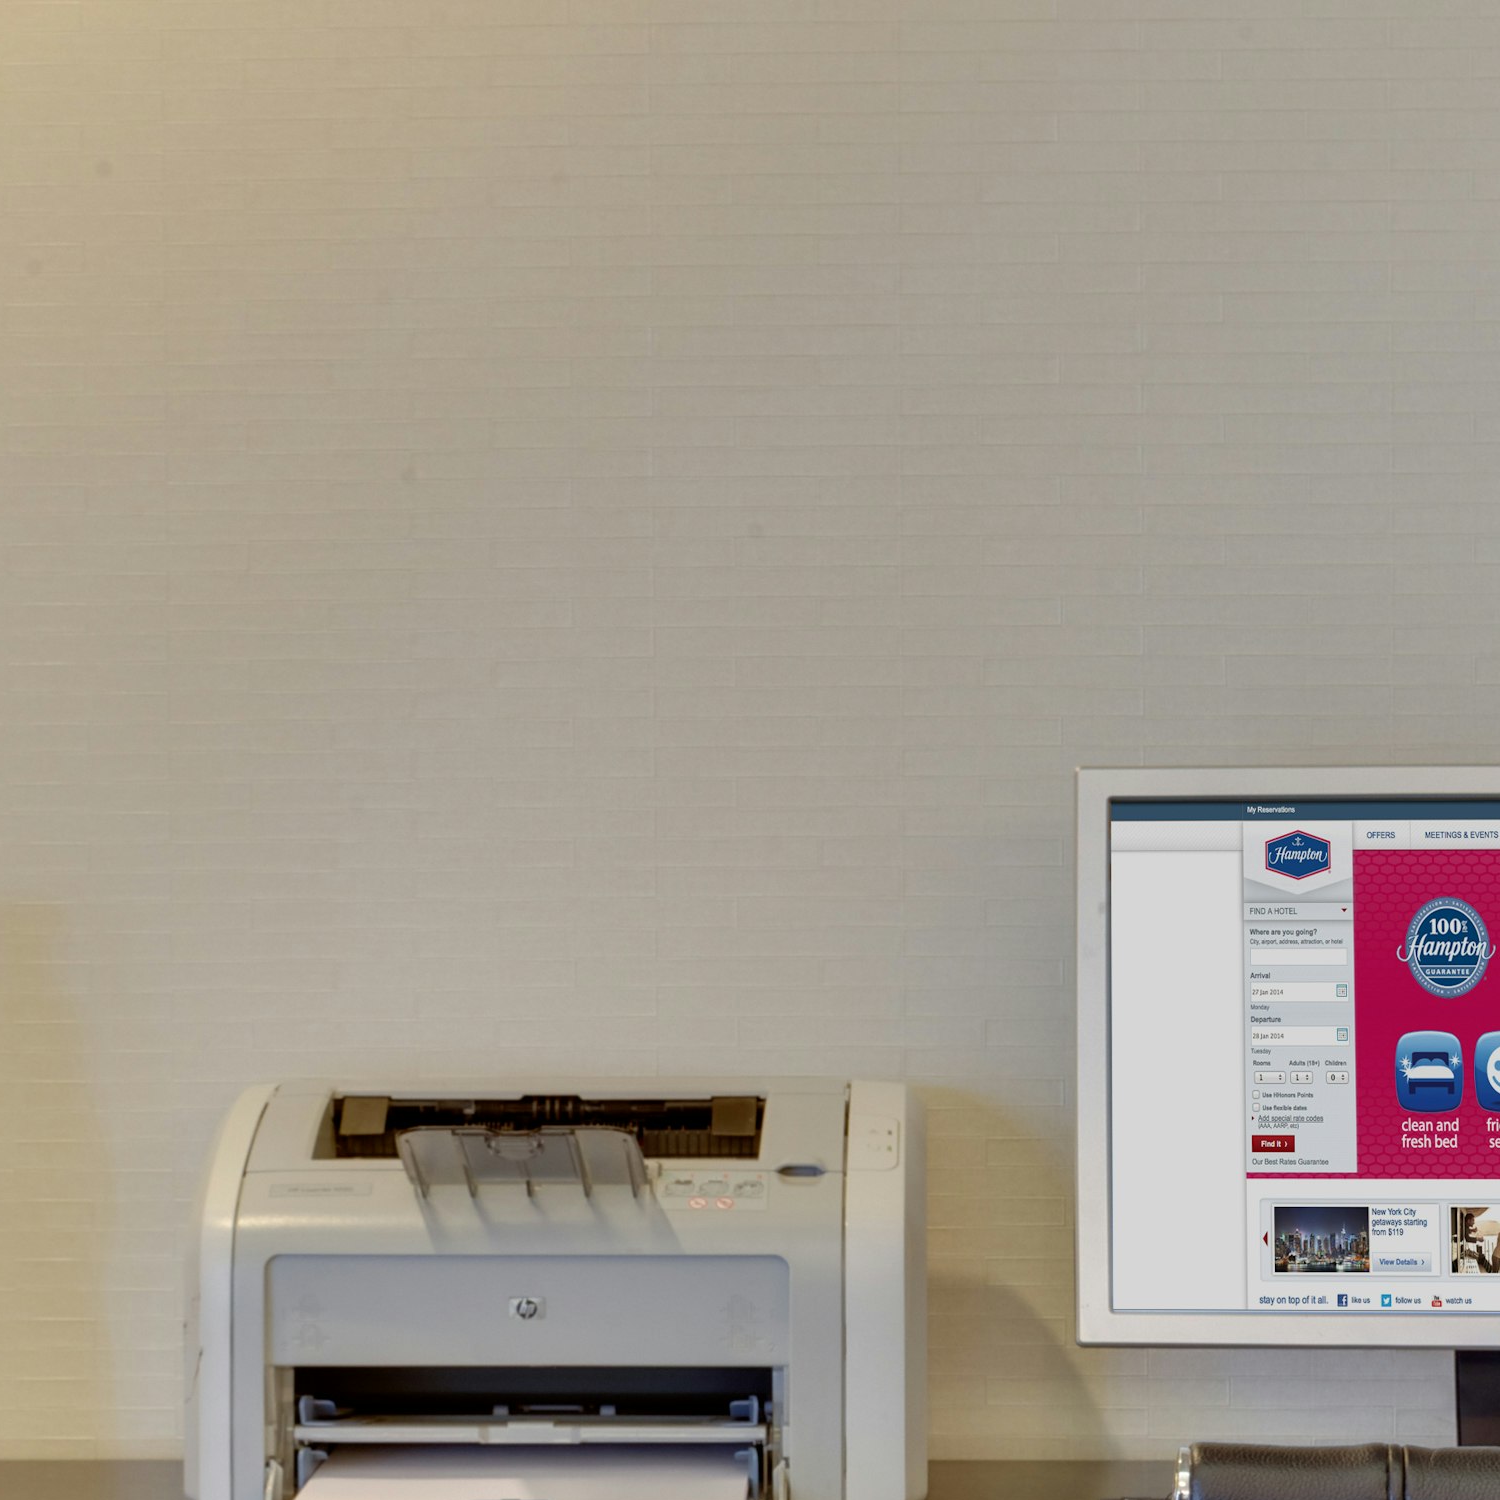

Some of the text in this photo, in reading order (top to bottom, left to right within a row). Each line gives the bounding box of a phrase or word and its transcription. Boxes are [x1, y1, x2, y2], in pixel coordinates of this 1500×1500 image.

[1246, 806, 1257, 814] My
[1366, 831, 1396, 839] OFFERS
[1425, 831, 1499, 839] MEETINGS & EVENTS
[1268, 846, 1328, 864] Hampton
[1396, 933, 1497, 962] Hampton
[1250, 1016, 1282, 1024] Departure
[1271, 1115, 1292, 1123] special
[1401, 1117, 1460, 1132] clean and
[1401, 1134, 1458, 1148] fresh bed
[1403, 1208, 1417, 1217] City
[1371, 1219, 1428, 1227] getaways starting
[1371, 1228, 1404, 1236] from $119
[1259, 1296, 1275, 1306] stay
[1288, 1296, 1300, 1306] top
[1301, 1295, 1310, 1304] of
[1311, 1295, 1316, 1304] it
[1317, 1295, 1329, 1304] all.
[1351, 1296, 1362, 1304] like
[1395, 1296, 1413, 1304] follow
[1445, 1296, 1464, 1304] watch
